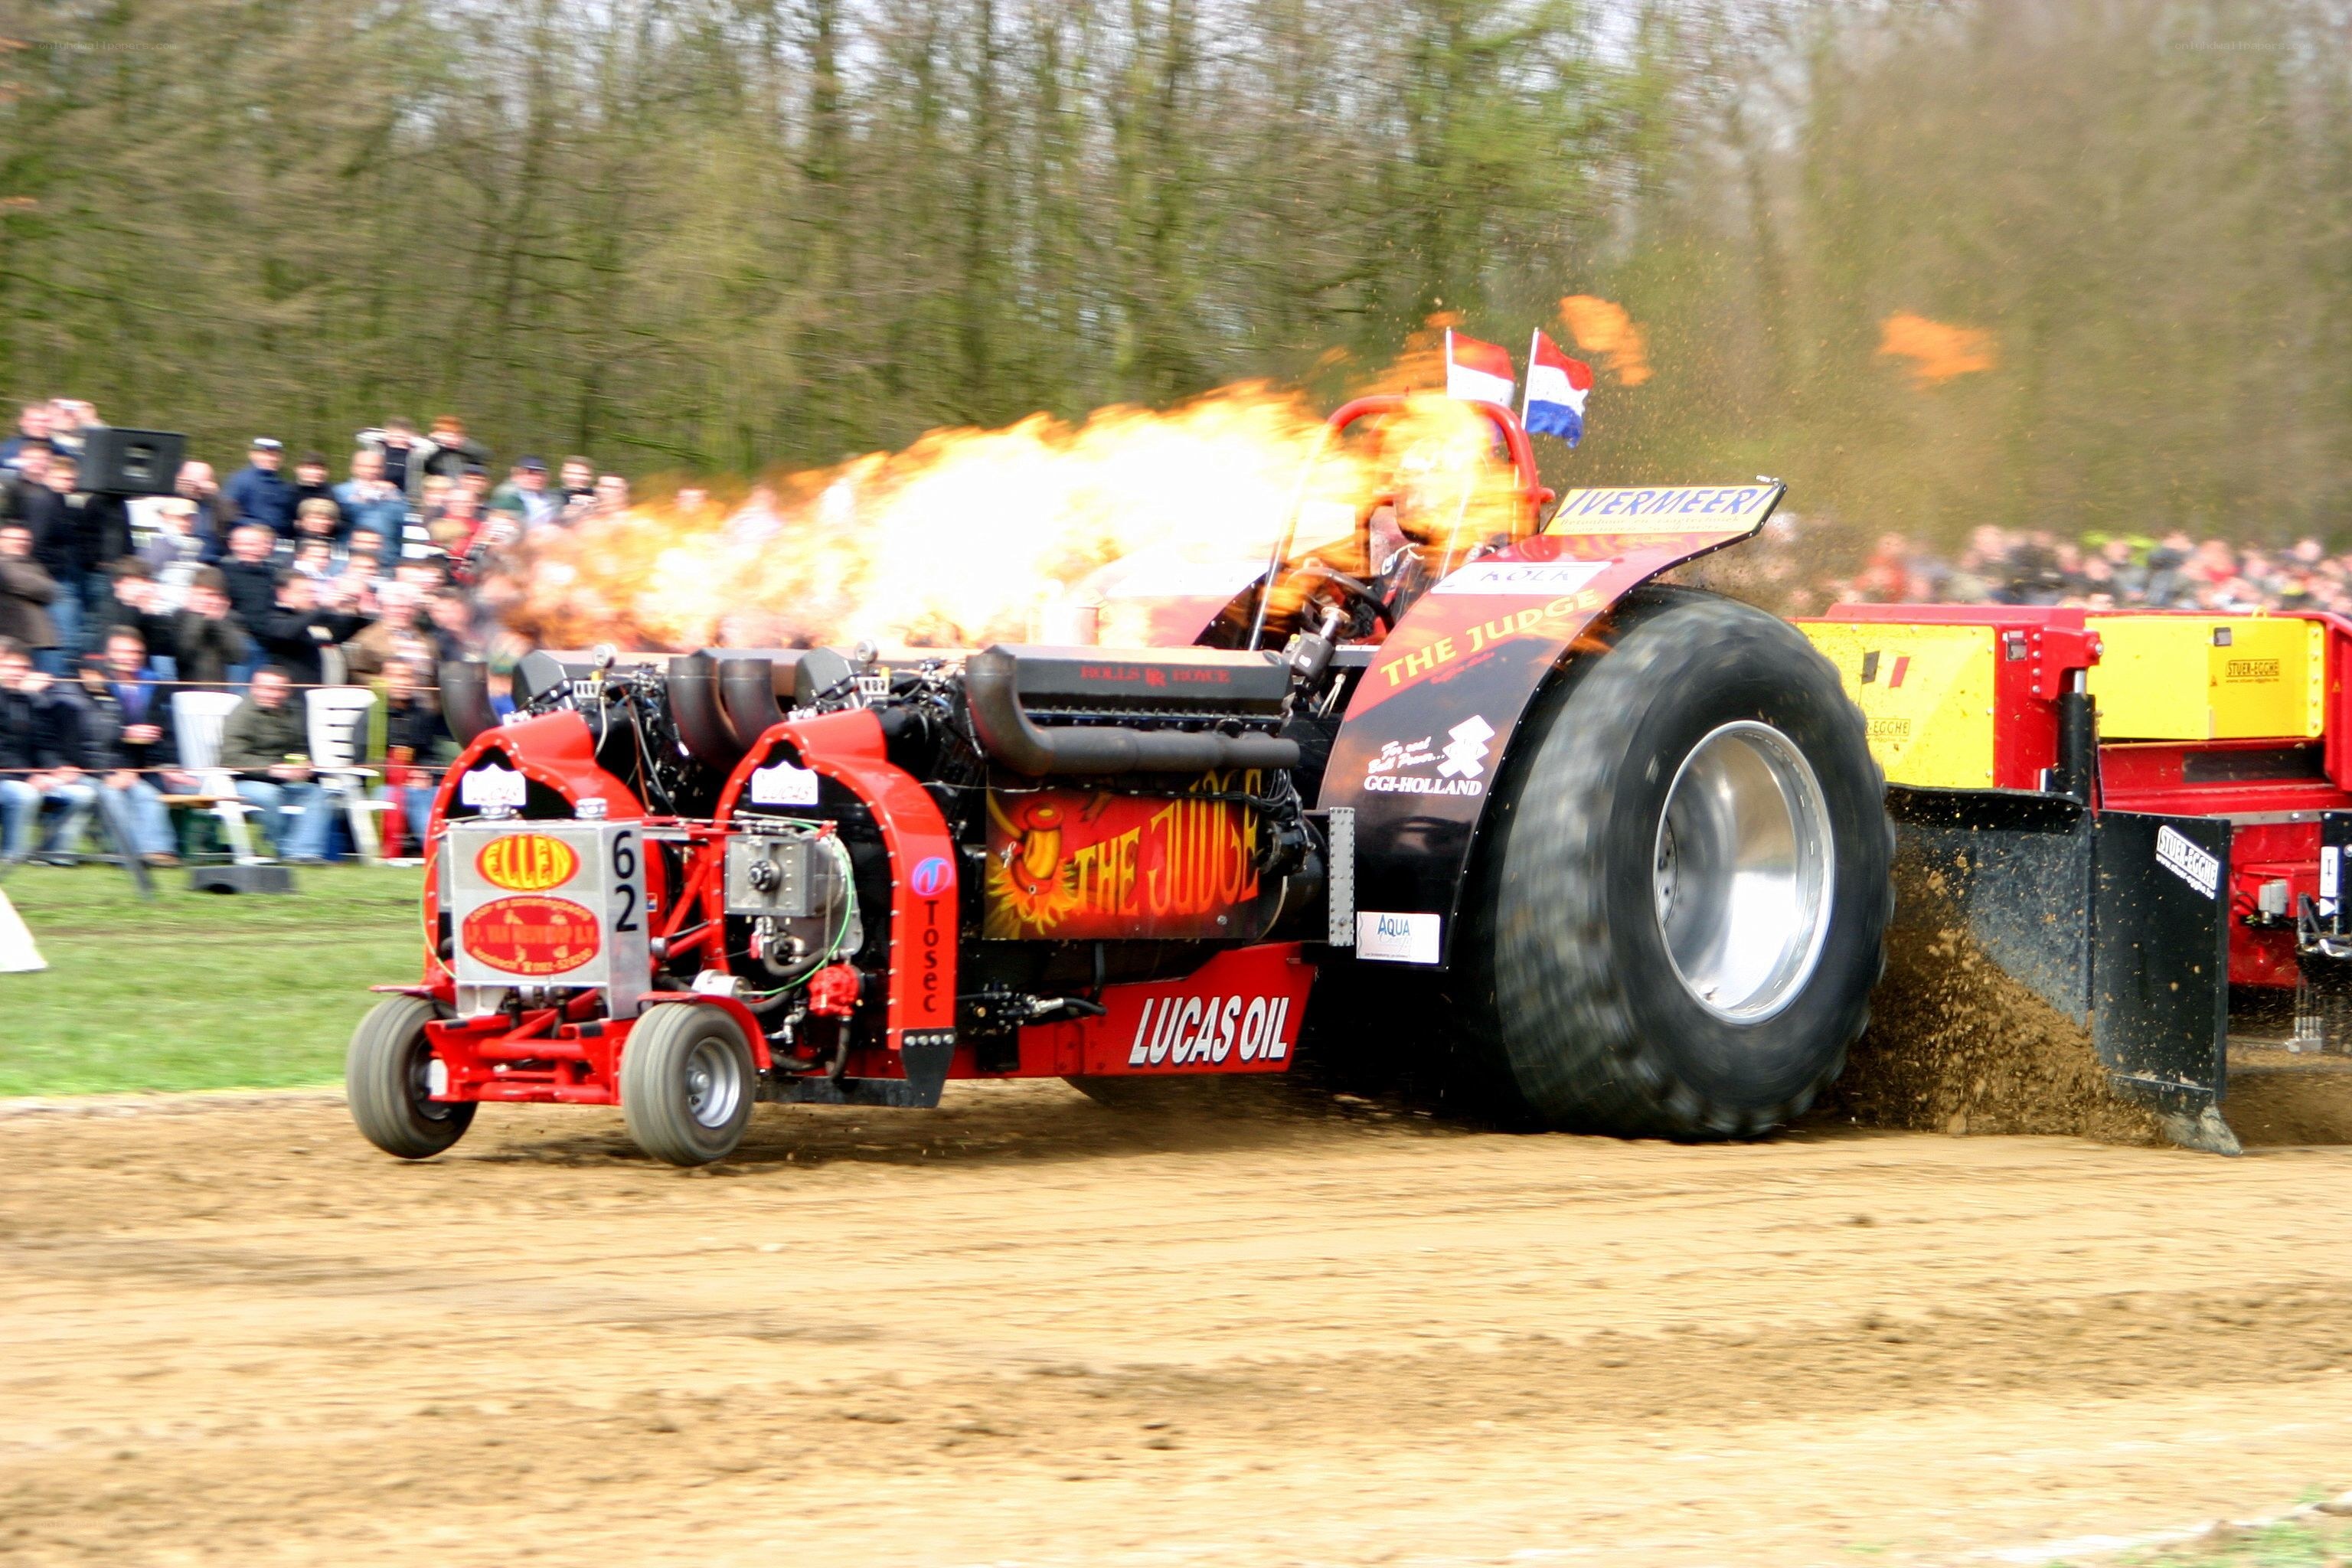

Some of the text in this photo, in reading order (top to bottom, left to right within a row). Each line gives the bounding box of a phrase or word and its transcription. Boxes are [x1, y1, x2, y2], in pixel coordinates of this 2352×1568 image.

[1380, 636, 1457, 687] THE
[1465, 588, 1599, 653] JUDGE
[1080, 665, 1140, 681] ROLLS
[1171, 668, 1232, 684] ROYCE
[2227, 662, 2278, 675] STUER-EGGHE
[1864, 720, 1909, 734] R-EGGHE
[1364, 775, 1482, 796] GGI-HOLLAND
[482, 835, 573, 889] ELLEN
[1072, 768, 1263, 918] THE JUDGE
[2158, 828, 2218, 890] STUER-EGGHE
[1377, 913, 1410, 936] AQUA
[1128, 995, 1290, 1064] LUCAS OIL
